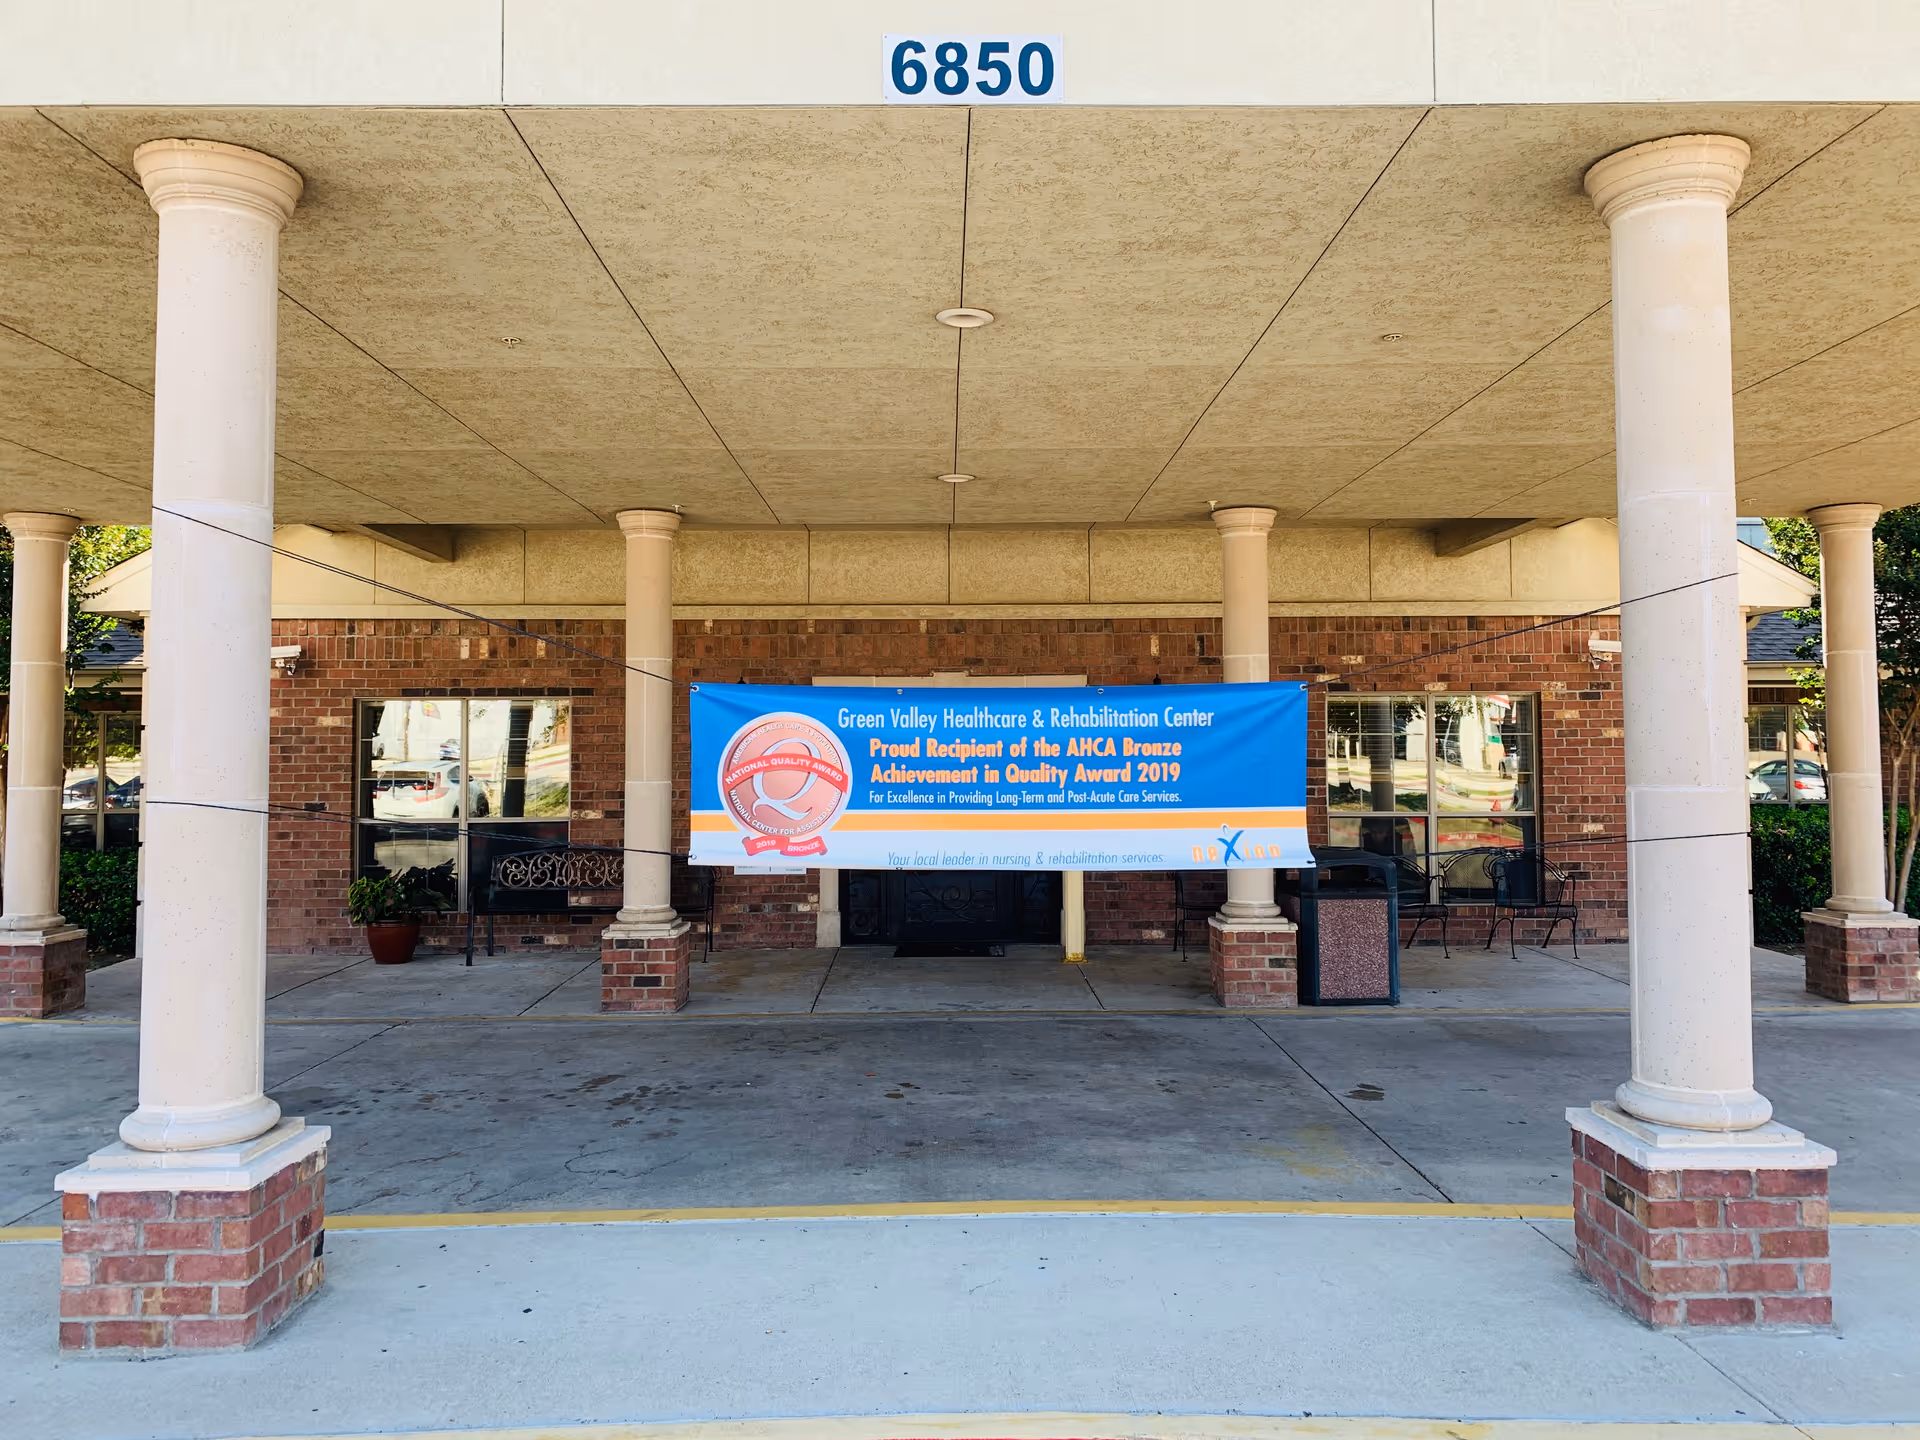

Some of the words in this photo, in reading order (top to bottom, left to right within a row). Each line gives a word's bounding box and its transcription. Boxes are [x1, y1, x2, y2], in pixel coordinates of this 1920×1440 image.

[891, 40, 1054, 96] 6850
[838, 707, 885, 728] Green
[890, 706, 937, 733] Valley
[943, 706, 1027, 728] Healthcare
[1032, 709, 1045, 728] &
[1050, 706, 1158, 728] Rehabilitation
[1164, 706, 1214, 727] Center
[869, 737, 920, 758] Proud
[926, 738, 1003, 763] Recipient
[1009, 736, 1027, 757] of
[1033, 736, 1061, 757] the
[1066, 737, 1117, 757] AHCA
[1122, 737, 1182, 757] Bronze
[725, 758, 769, 784] NATIONAL
[770, 757, 812, 767] QUALITY
[812, 762, 843, 782] AWARD
[870, 763, 979, 783] Achievement
[984, 764, 1000, 783] in
[1005, 762, 1068, 789] Quality
[1074, 761, 1131, 782] Award
[1137, 762, 1181, 782] 2019
[869, 791, 884, 803] For
[887, 790, 934, 803] Excellence
[937, 792, 946, 803] in
[949, 790, 993, 806] Providing
[996, 790, 1044, 806] Long-Term
[1047, 789, 1065, 803] and
[1068, 790, 1115, 803] Post-Acute
[1118, 790, 1139, 803] Care
[1142, 790, 1182, 803] Services.
[730, 789, 751, 821] NATIONAL
[751, 819, 778, 835] CENTER
[756, 839, 776, 849] 2019
[787, 841, 820, 852] BRONZE
[888, 852, 910, 866] Your
[914, 850, 939, 866] local
[942, 850, 975, 866] leader
[979, 853, 989, 865] in
[992, 853, 1031, 867] nursing
[1035, 851, 1044, 865] &
[1048, 850, 1118, 865] rehabilitation
[1122, 852, 1167, 864] services.
